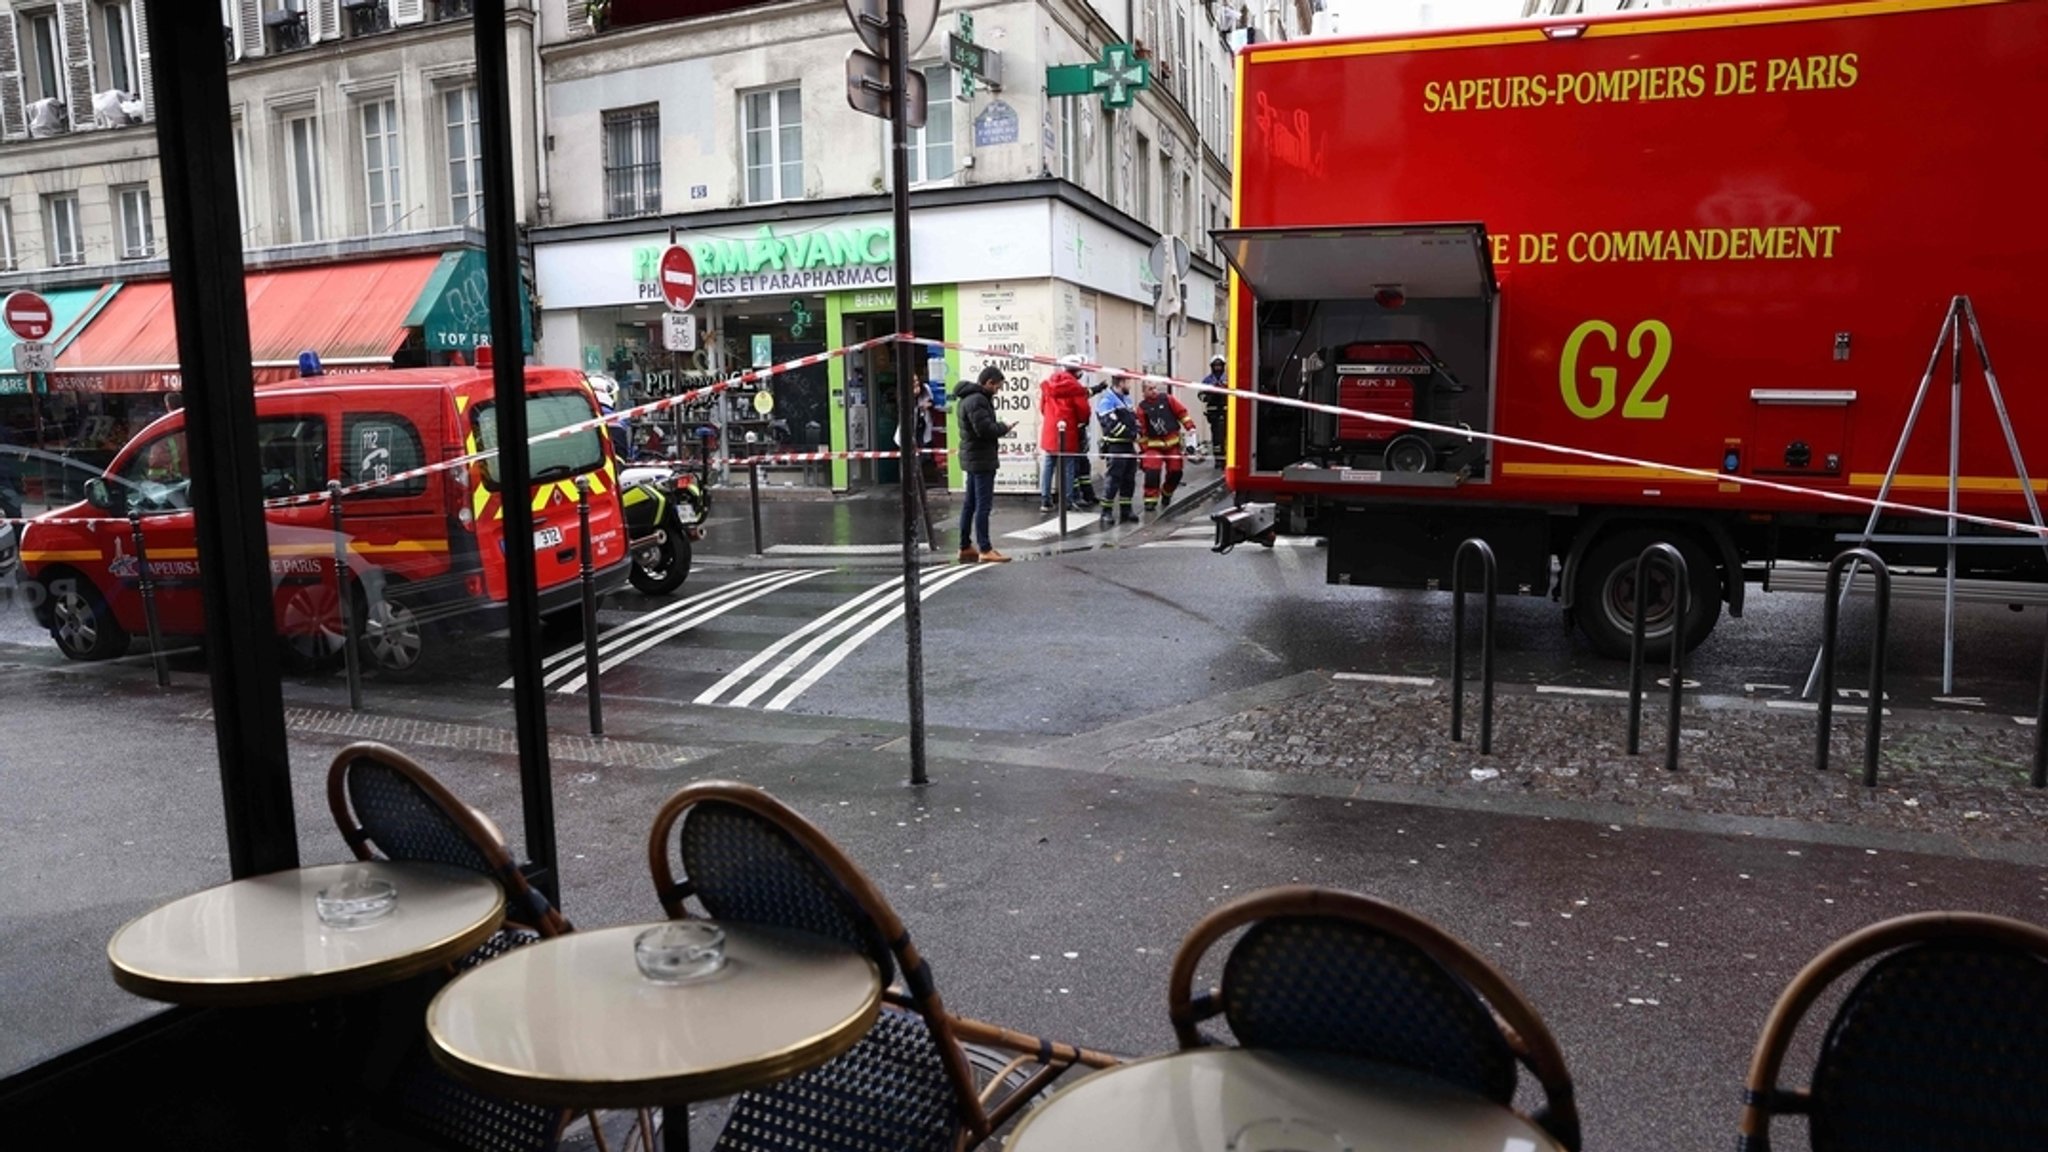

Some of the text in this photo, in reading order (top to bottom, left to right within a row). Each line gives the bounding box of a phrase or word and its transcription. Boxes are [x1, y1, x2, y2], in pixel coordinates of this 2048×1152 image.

[1423, 53, 1859, 112] SAPEURS-POMPIERS DE PARIS
[1518, 232, 1558, 264] DE
[1567, 226, 1841, 263] COMMANDEMENT
[632, 225, 894, 282] PHRMAVANC
[740, 276, 755, 292] ET
[855, 290, 929, 307] BIENVUE
[987, 322, 1019, 332] LEVINE
[438, 332, 468, 345] TOP
[1560, 319, 1672, 419] G2
[56, 377, 103, 389] SERVICE
[1000, 377, 1029, 392] h30
[1385, 378, 1397, 388] 32
[992, 395, 1031, 411] 0h30
[363, 431, 379, 450] 112
[373, 463, 388, 482] 18
[282, 559, 323, 573] PARIS
